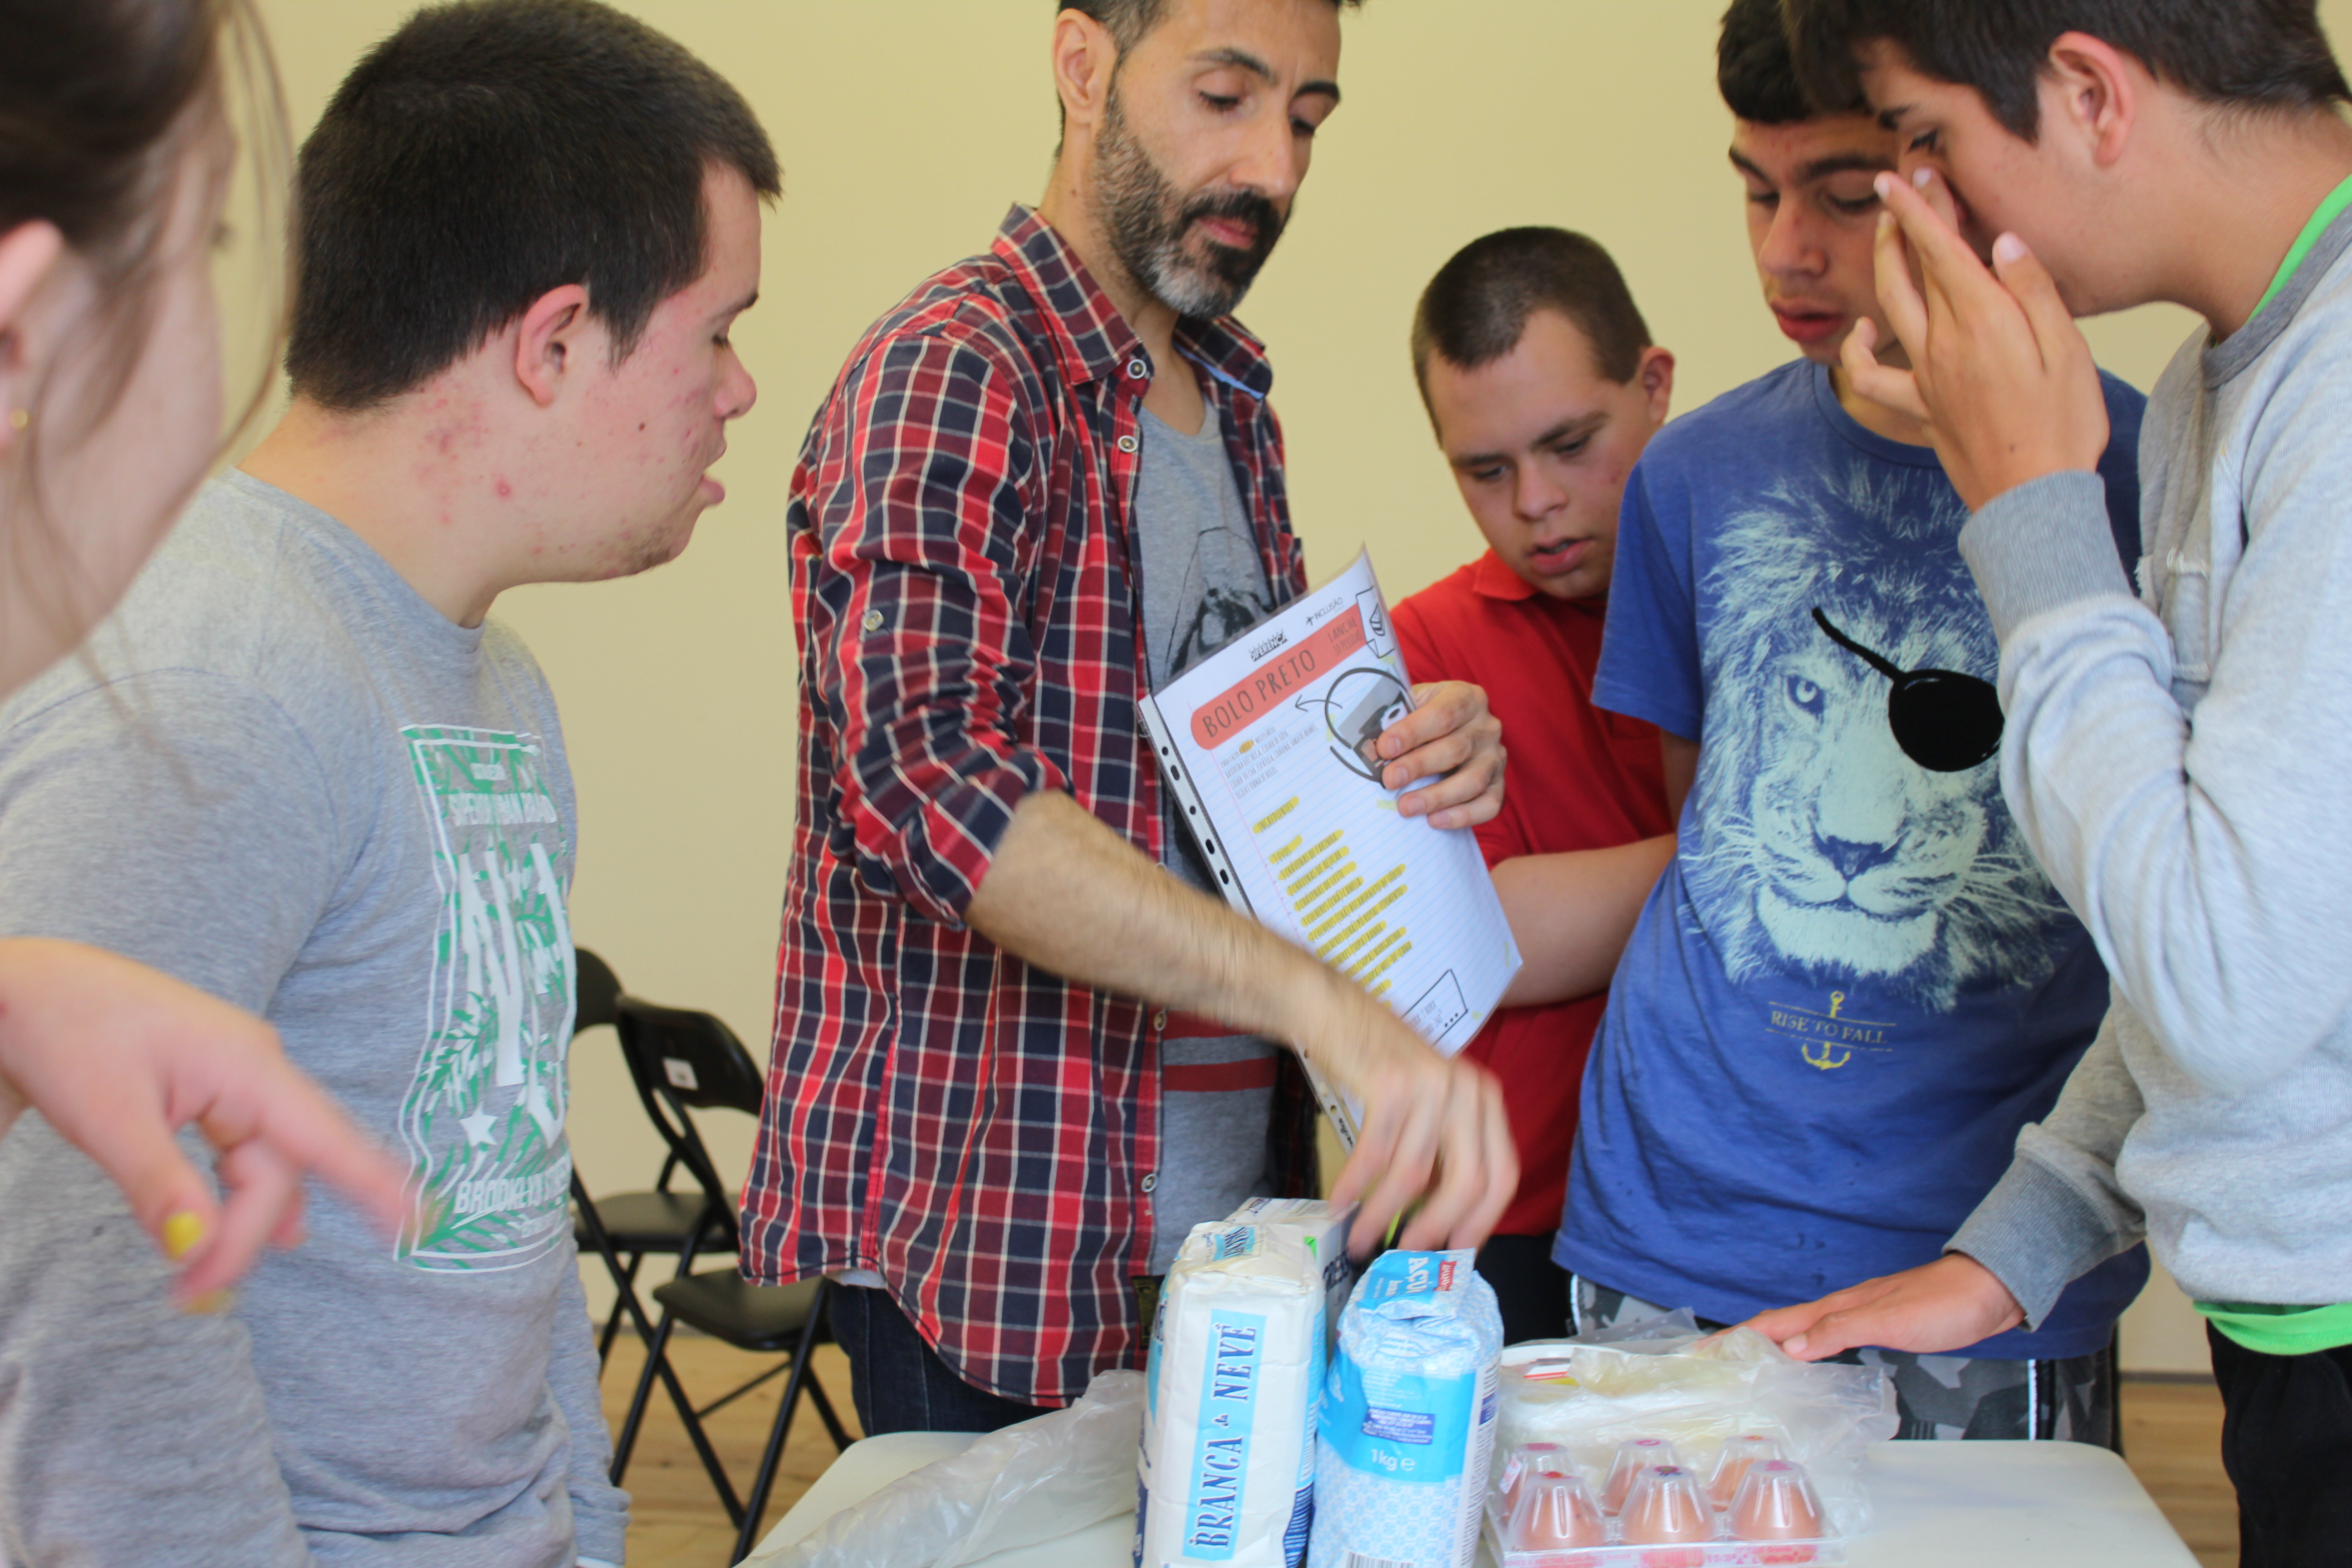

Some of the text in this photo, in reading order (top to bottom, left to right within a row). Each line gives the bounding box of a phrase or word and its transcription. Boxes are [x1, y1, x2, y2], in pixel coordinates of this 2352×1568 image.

[1313, 595, 1344, 620] INCLUSÃO
[1327, 616, 1358, 643] LANCHE
[1339, 629, 1364, 652] PESSOAS
[1249, 632, 1288, 662] DIFERENÇA
[1201, 647, 1318, 738] BOLO PRETO
[1256, 800, 1295, 833] INGREDIENTES
[1276, 845, 1293, 862] OVOS
[1771, 1011, 1888, 1043] RISE TO FALL
[453, 1173, 544, 1214] BROOKLYN
[1212, 1323, 1257, 1402] NEVE
[1371, 1449, 1398, 1471] 1kg
[1187, 1436, 1243, 1549] BRANCA
